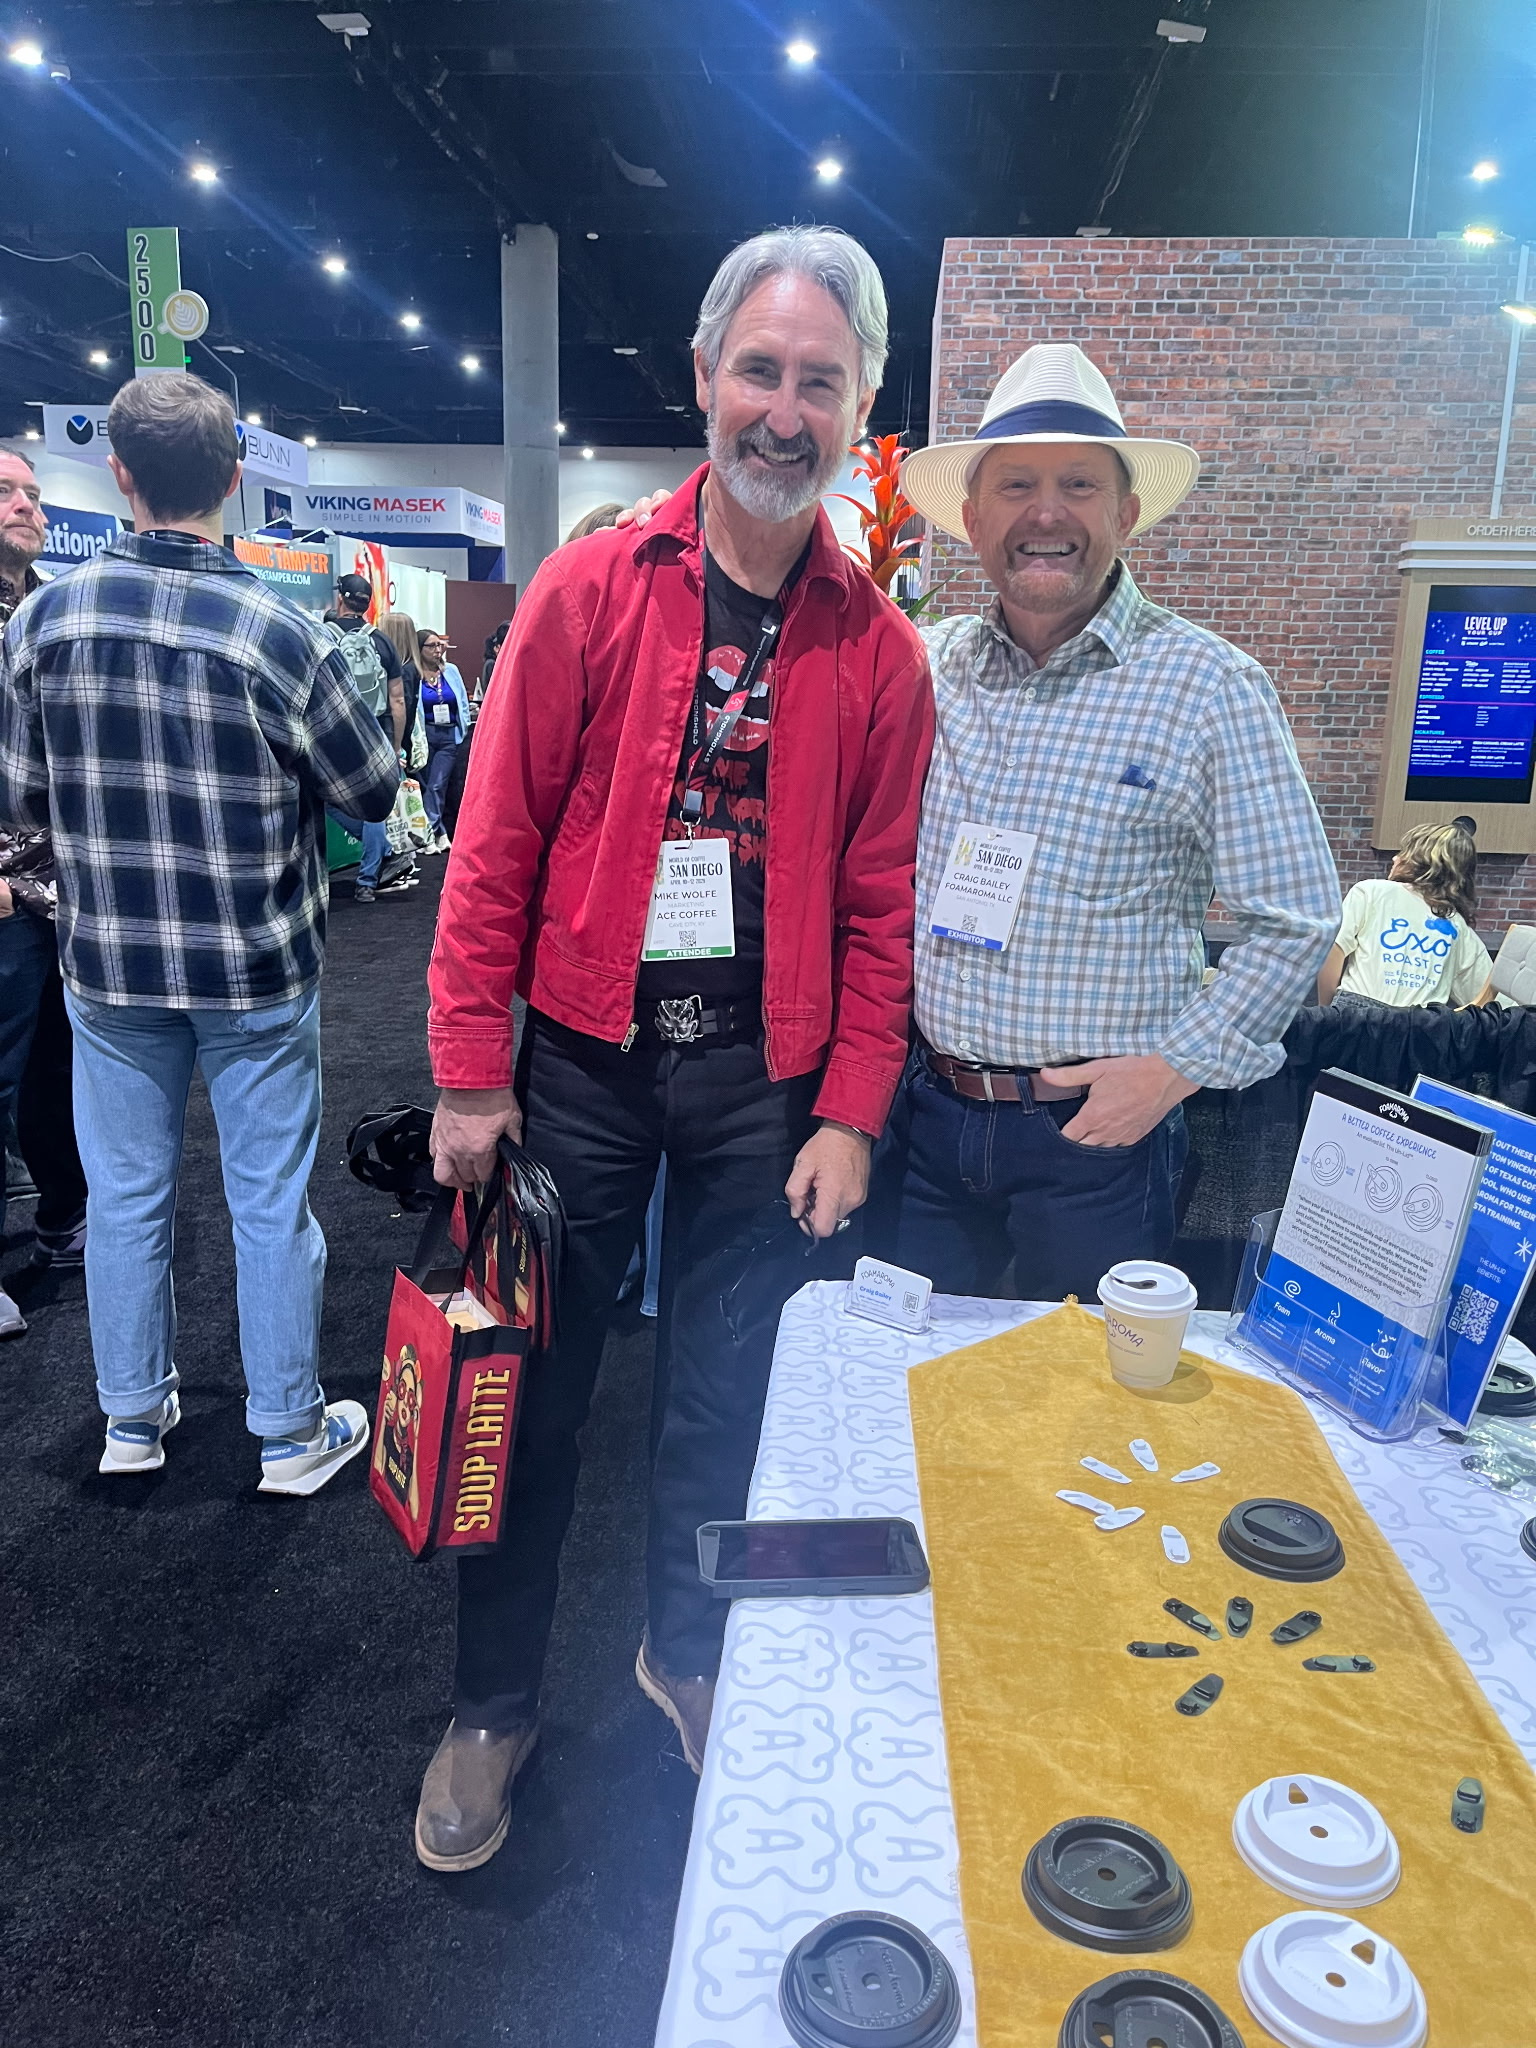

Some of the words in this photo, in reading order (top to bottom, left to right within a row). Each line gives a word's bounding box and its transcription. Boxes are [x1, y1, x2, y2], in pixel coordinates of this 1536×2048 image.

[134, 234, 156, 363] 2500
[248, 435, 291, 467] BUNN
[322, 512, 364, 522] SIMPLE
[369, 513, 381, 522] IN
[387, 513, 432, 524] MOTION
[1467, 525, 1508, 537] ORDER
[274, 547, 329, 574] TAMPER
[1464, 616, 1491, 630] LEVEL
[1493, 617, 1507, 630] UP
[704, 715, 731, 763] STRONGHOLD
[976, 849, 994, 865] SAN
[994, 852, 1022, 870] DIEGO
[669, 864, 688, 878] SAN
[692, 863, 723, 877] DIEGO
[954, 872, 979, 883] CRAIG
[980, 878, 1010, 890] BAILEY
[654, 892, 678, 900] MIKE
[681, 890, 717, 899] WOLFE
[945, 882, 996, 900] FOAMAROMA
[998, 894, 1013, 903] LLC
[657, 912, 676, 920] ACE
[679, 910, 717, 919] COFFEE
[947, 930, 986, 945] EXHIBITOR
[1380, 918, 1451, 957] Exo
[667, 948, 711, 957] ATTENDEE
[1383, 953, 1429, 969] ROAST
[1379, 1102, 1410, 1123] FOAMAROMA
[1342, 1112, 1347, 1121] A
[1347, 1115, 1369, 1131] BETTER
[1370, 1124, 1394, 1141] COFFEE
[1395, 1135, 1437, 1159] EXPERIENCE
[1492, 1153, 1507, 1164] TOM
[1496, 1140, 1511, 1153] OUT
[1511, 1146, 1533, 1161] THESE
[1489, 1166, 1499, 1175] OF
[1499, 1171, 1522, 1185] TEXAS
[1522, 1180, 1536, 1192] COF
[1500, 1185, 1517, 1198] WHO
[1517, 1193, 1532, 1205] USE
[1487, 1208, 1522, 1231] TRAINING.
[1499, 1199, 1514, 1211] FOR
[1515, 1206, 1536, 1222] THEIR
[861, 1269, 895, 1288] FOAMAROMA
[1273, 1301, 1291, 1317] Foam
[1105, 1312, 1144, 1348] AROMA
[1314, 1327, 1337, 1345] Aroma
[465, 1367, 511, 1451] LATTE
[454, 1455, 498, 1533] SOUP
